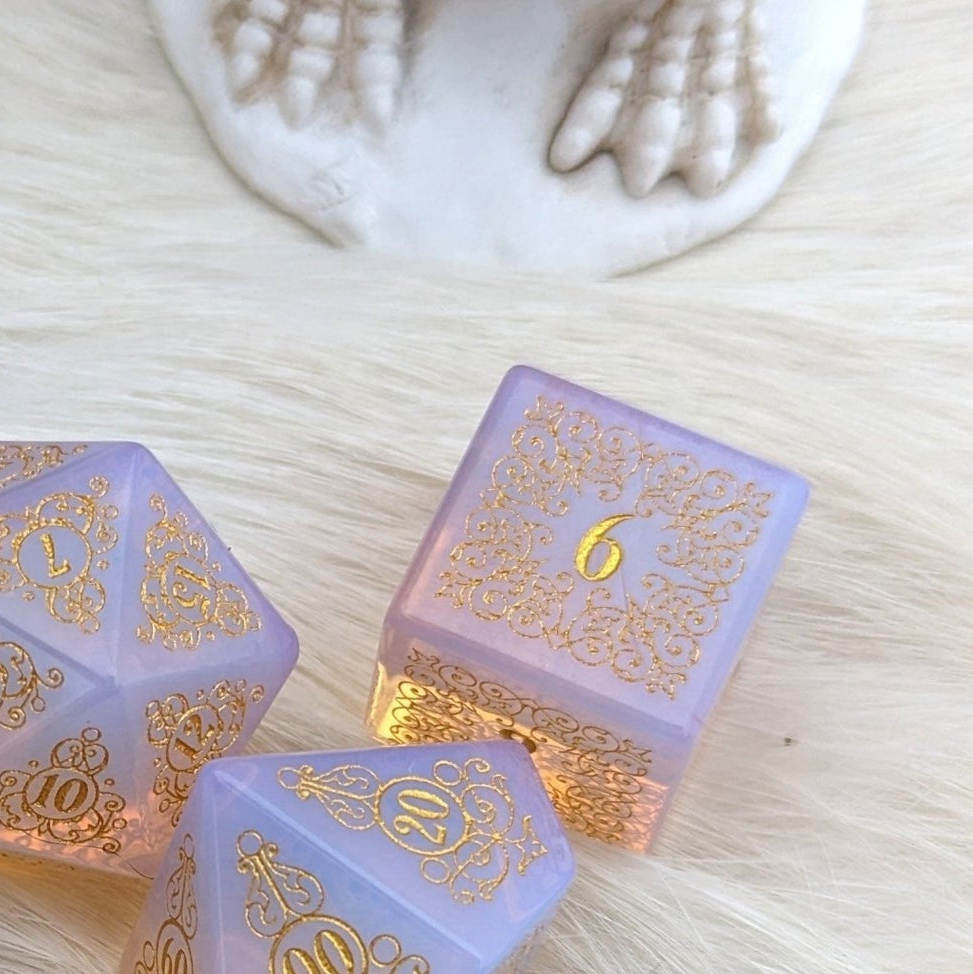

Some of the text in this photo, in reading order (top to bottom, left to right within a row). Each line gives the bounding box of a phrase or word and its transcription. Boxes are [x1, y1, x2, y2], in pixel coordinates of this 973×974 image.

[40, 532, 72, 579] 7
[573, 512, 636, 583] 6
[170, 562, 210, 616] 15
[173, 713, 215, 760] 12
[36, 772, 90, 815] 10
[393, 788, 450, 845] 20
